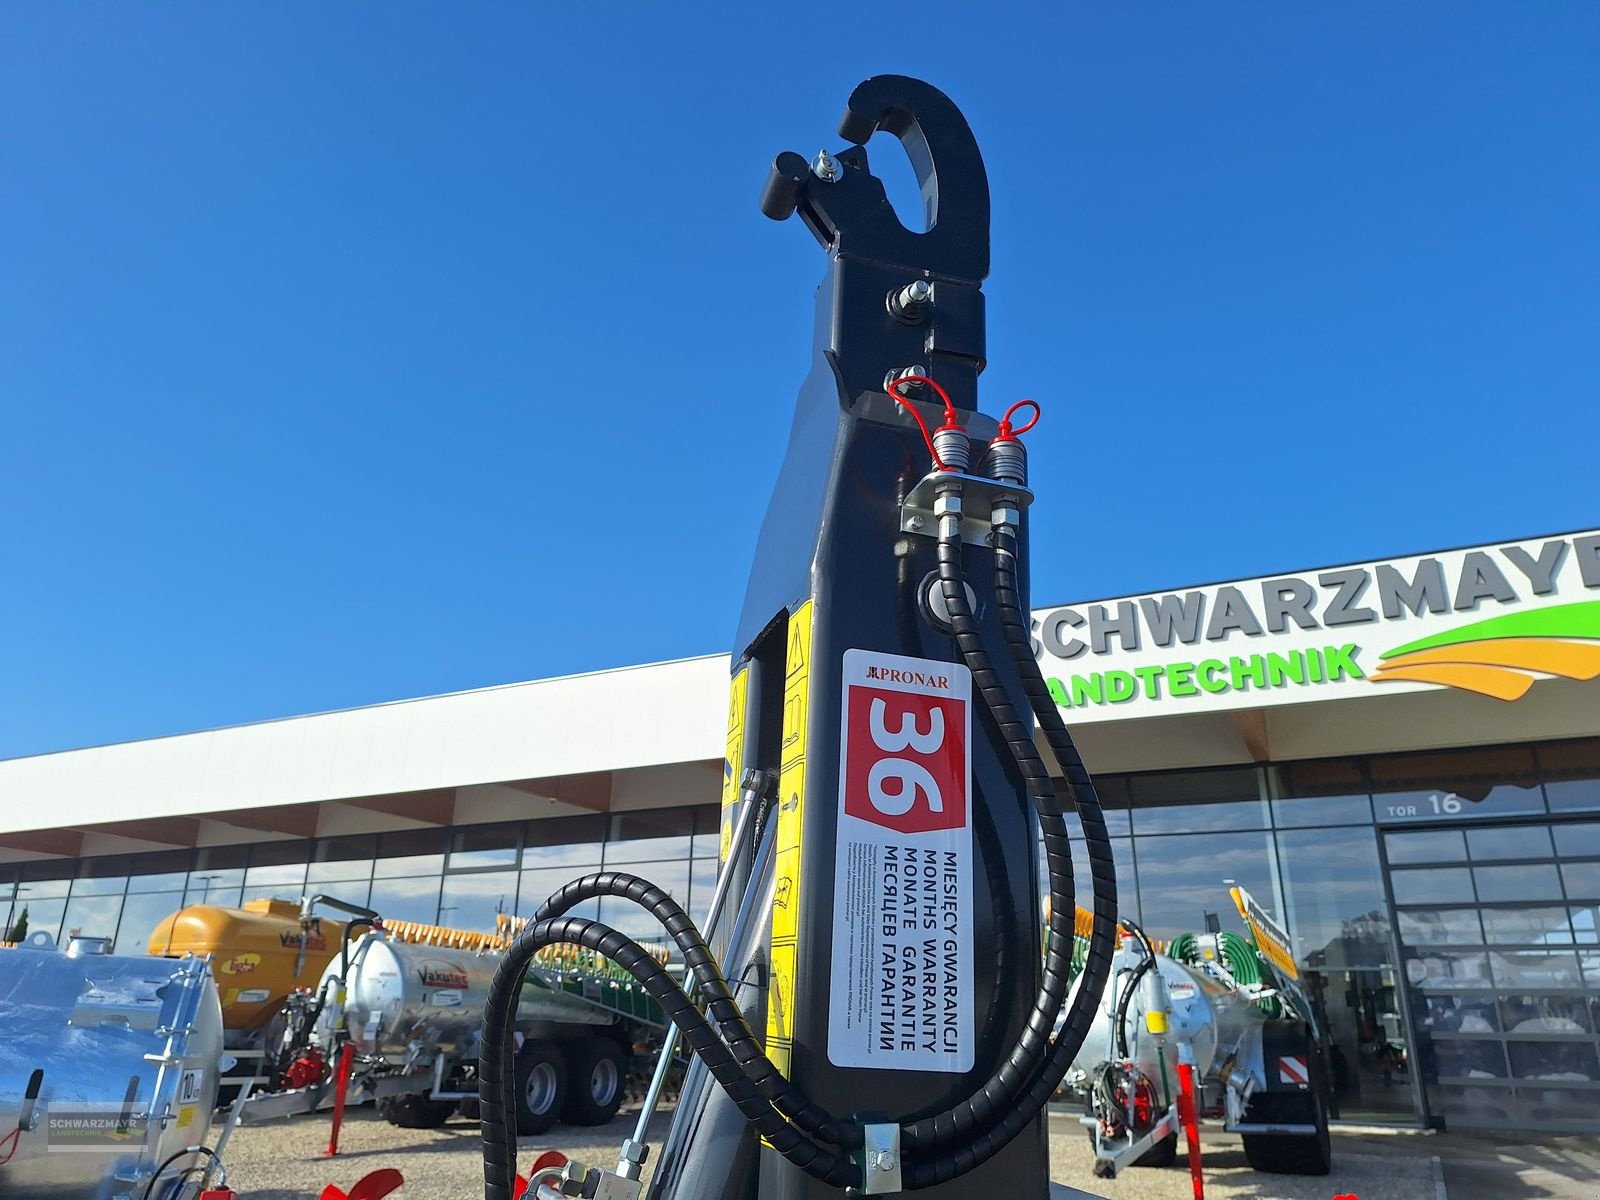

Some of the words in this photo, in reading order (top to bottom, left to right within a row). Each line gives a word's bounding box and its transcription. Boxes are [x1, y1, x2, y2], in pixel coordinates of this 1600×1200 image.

[880, 668, 949, 689] PRONAR
[1046, 643, 1365, 707] ANDTECHNIK
[867, 697, 945, 816] 36
[1387, 806, 1416, 816] TOR
[1428, 793, 1462, 815] 16
[881, 846, 898, 936] МЕСЯЦЕВ
[903, 848, 917, 929] MONATE
[923, 850, 936, 929] MONTHS
[941, 852, 957, 936] MIESIĘCY
[417, 968, 469, 989] Vakutec
[880, 944, 895, 1050] ГАРАНТИИ
[901, 946, 916, 1051] GARANTIE
[922, 939, 936, 1053] WARRANTY
[943, 939, 958, 1053] GWARANCJI
[183, 1073, 195, 1099] 10
